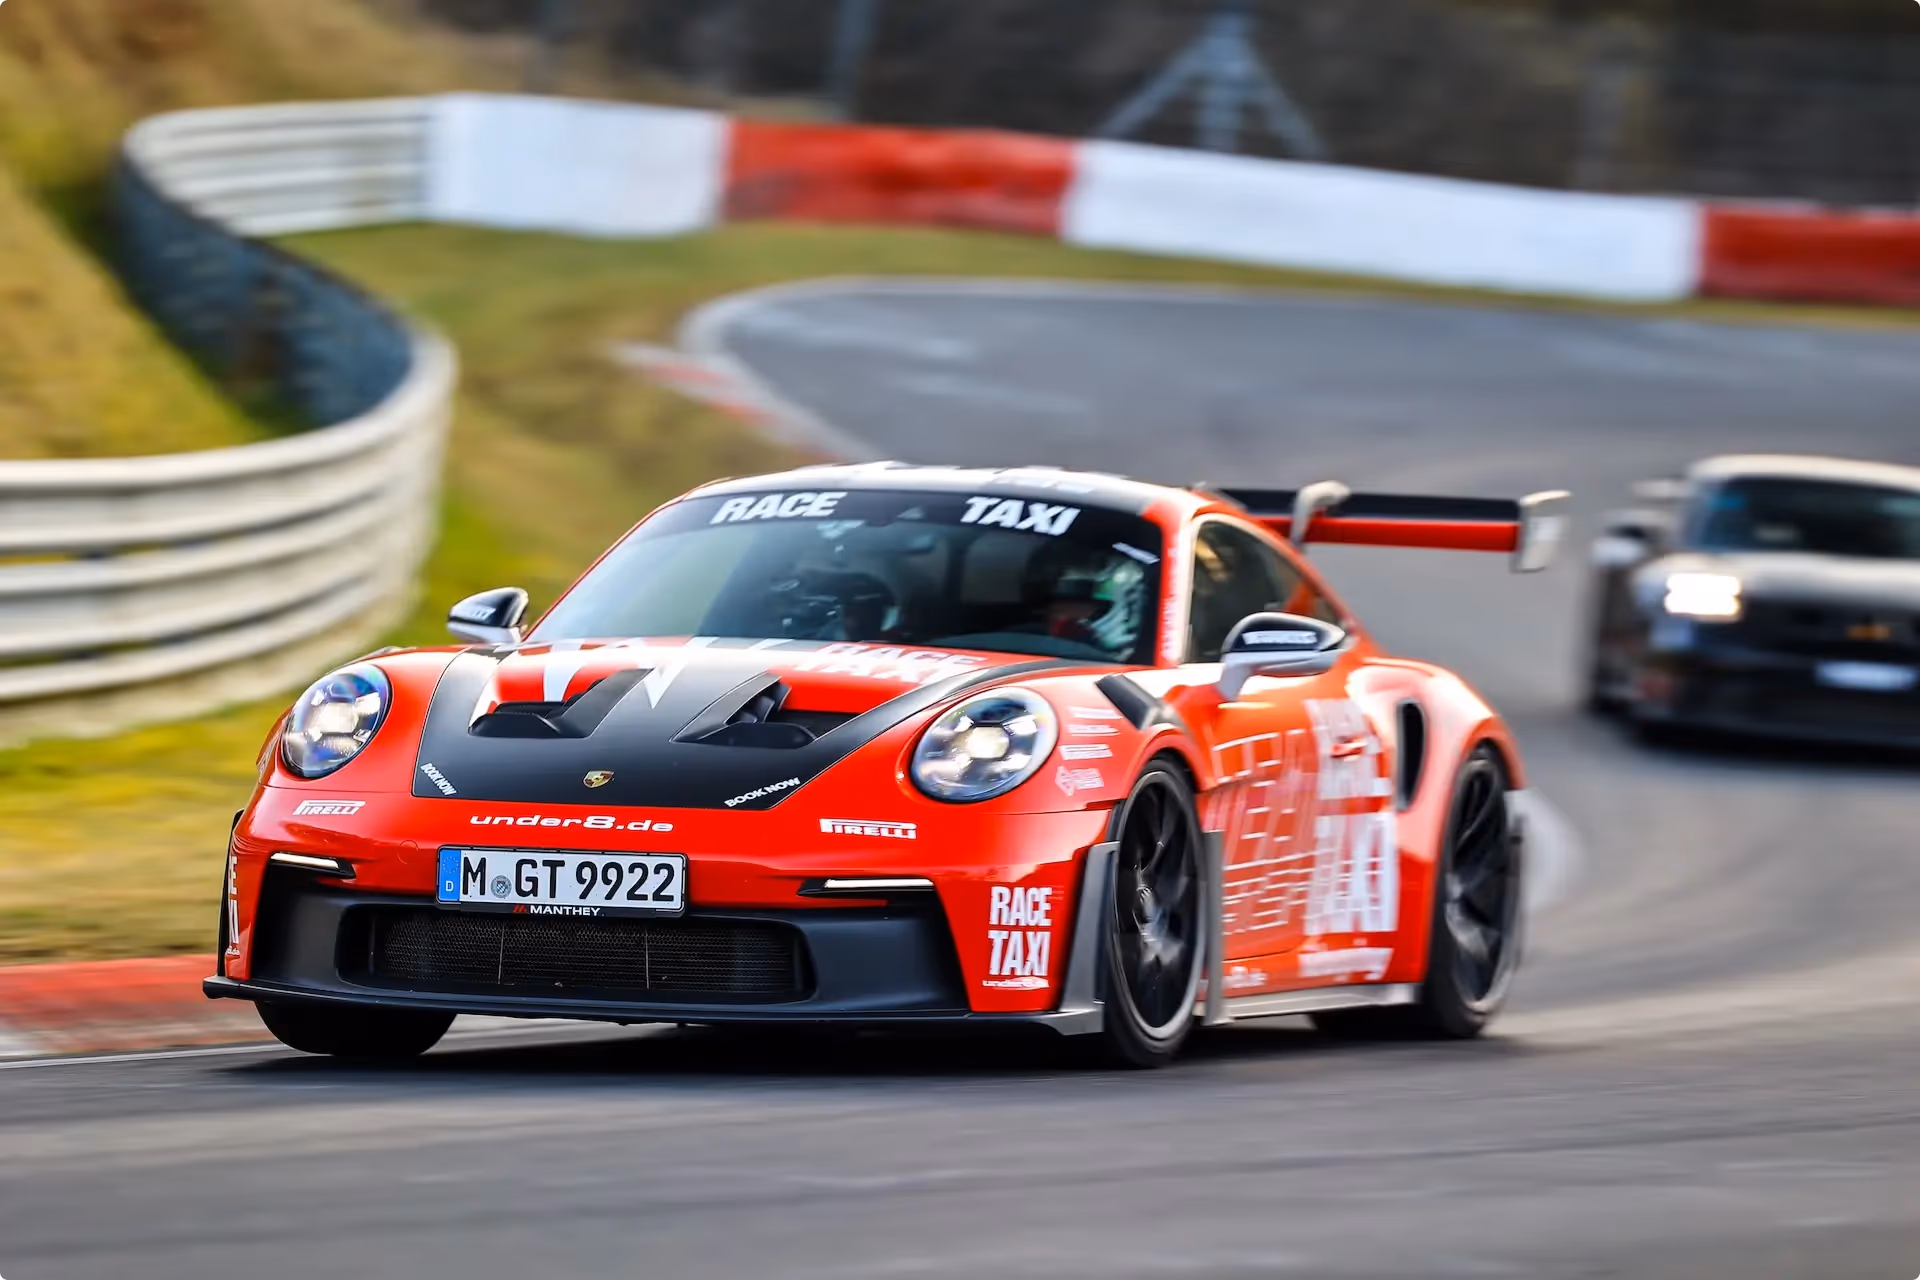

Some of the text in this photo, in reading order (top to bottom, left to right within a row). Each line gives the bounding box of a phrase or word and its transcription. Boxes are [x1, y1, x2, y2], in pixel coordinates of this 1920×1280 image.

[709, 491, 1081, 536] RACE TAXI
[434, 778, 457, 796] NOW
[724, 777, 801, 807] BOOK NOW
[292, 799, 367, 816] PIRELLI
[470, 815, 674, 832] under8.de
[819, 818, 917, 839] PIRELLI
[445, 880, 455, 892] D
[462, 856, 675, 902] M GT 9922
[530, 904, 601, 917] MANTHEY
[989, 886, 1052, 926] RACE
[987, 930, 1051, 976] TAXI
